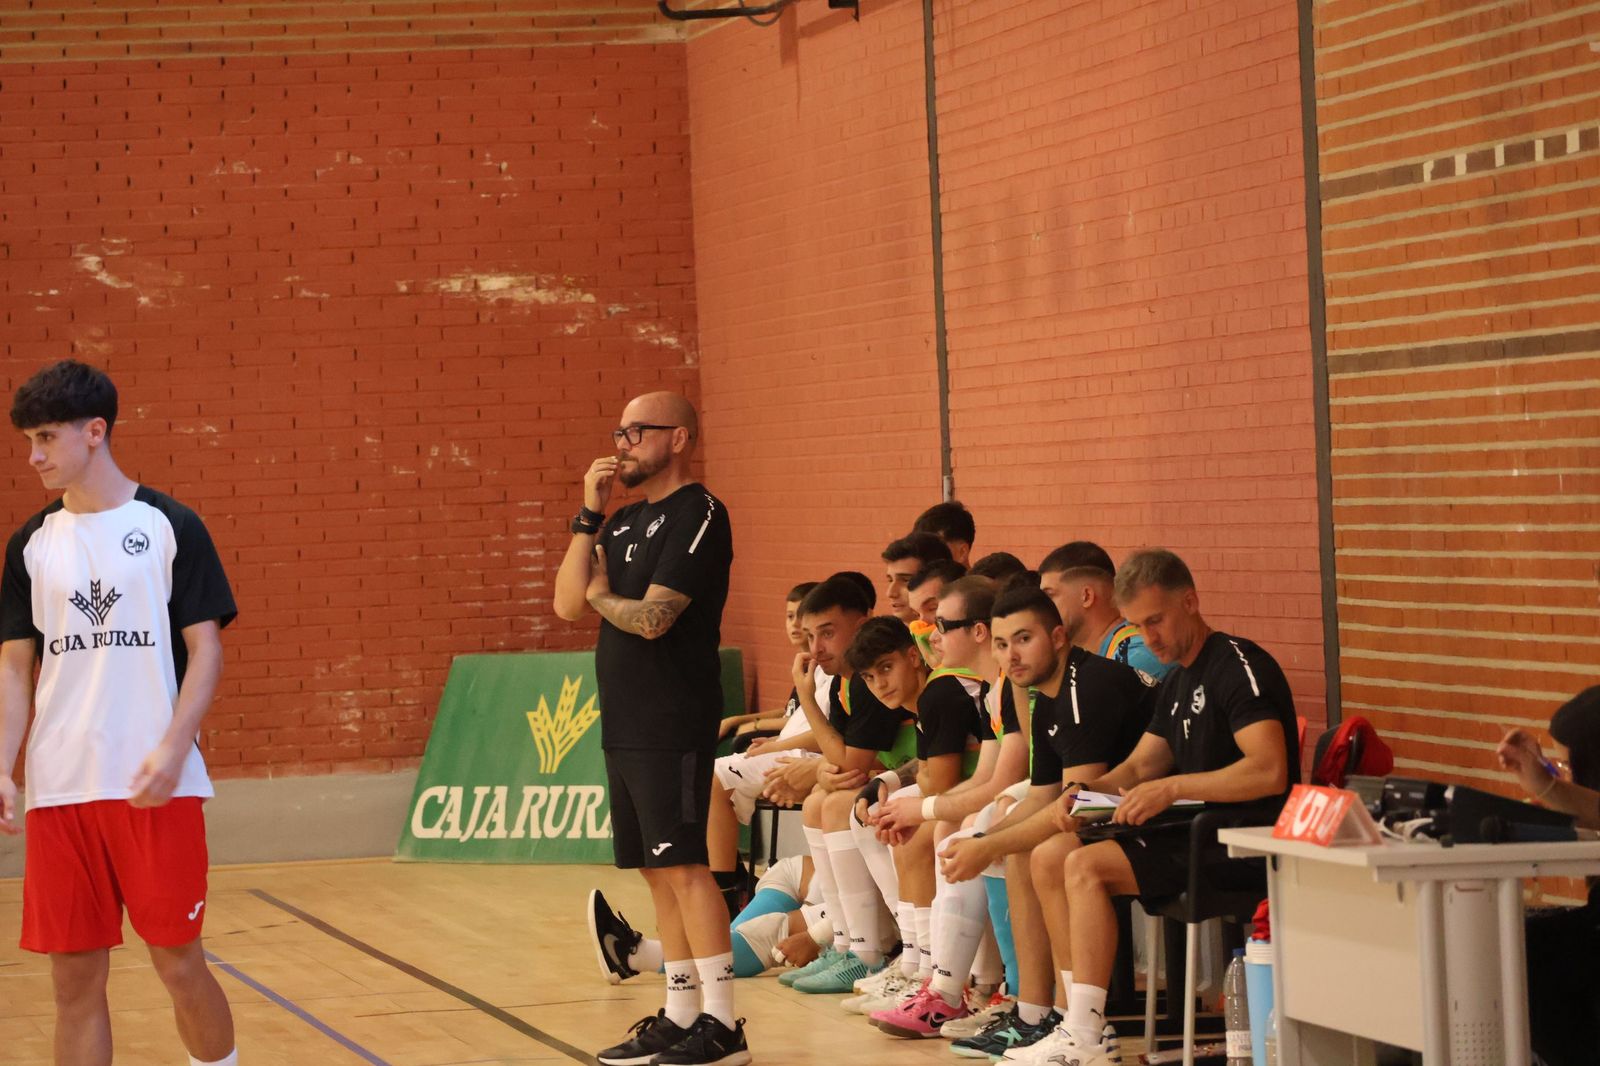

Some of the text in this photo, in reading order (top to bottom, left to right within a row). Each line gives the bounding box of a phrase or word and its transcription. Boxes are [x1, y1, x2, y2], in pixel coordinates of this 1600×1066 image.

[49, 630, 155, 656] CJA RURAL
[411, 785, 614, 842] CAJA RUR
